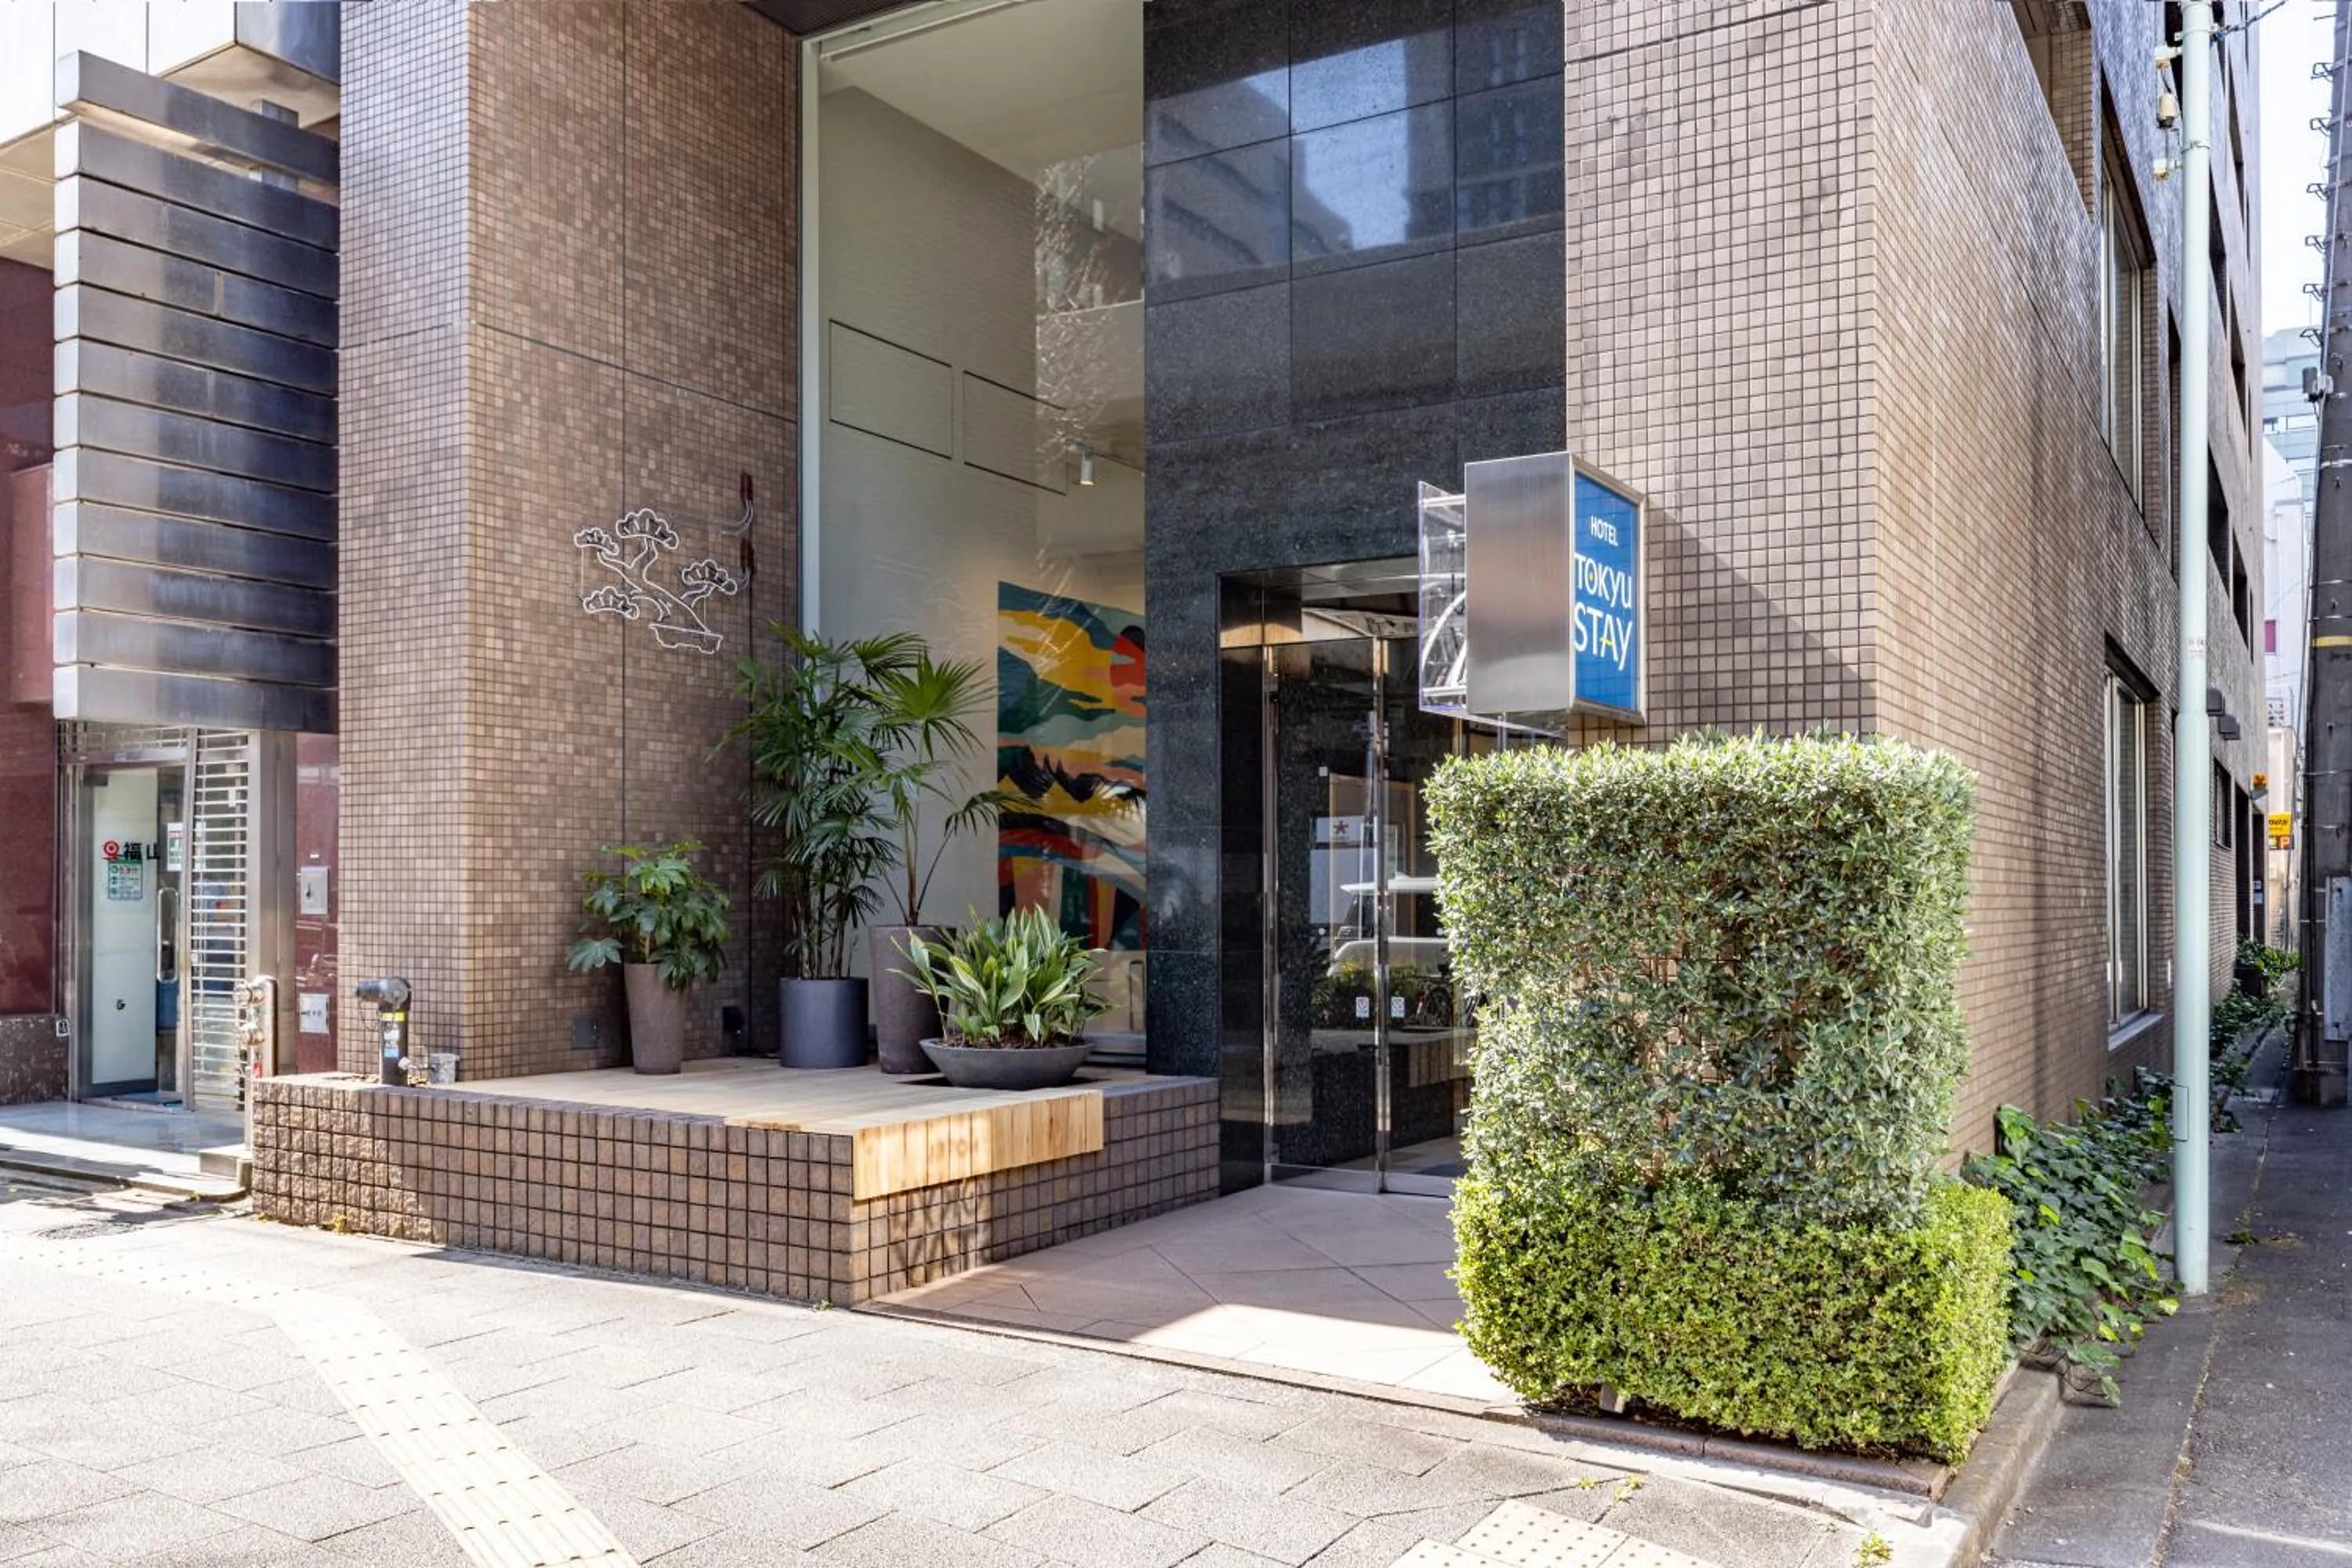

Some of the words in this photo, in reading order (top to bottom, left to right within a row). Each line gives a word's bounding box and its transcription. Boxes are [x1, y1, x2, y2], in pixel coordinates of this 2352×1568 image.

[1590, 515, 1618, 546] HOTEL
[1574, 552, 1632, 608] TOKYU
[1573, 601, 1633, 671] STAY
